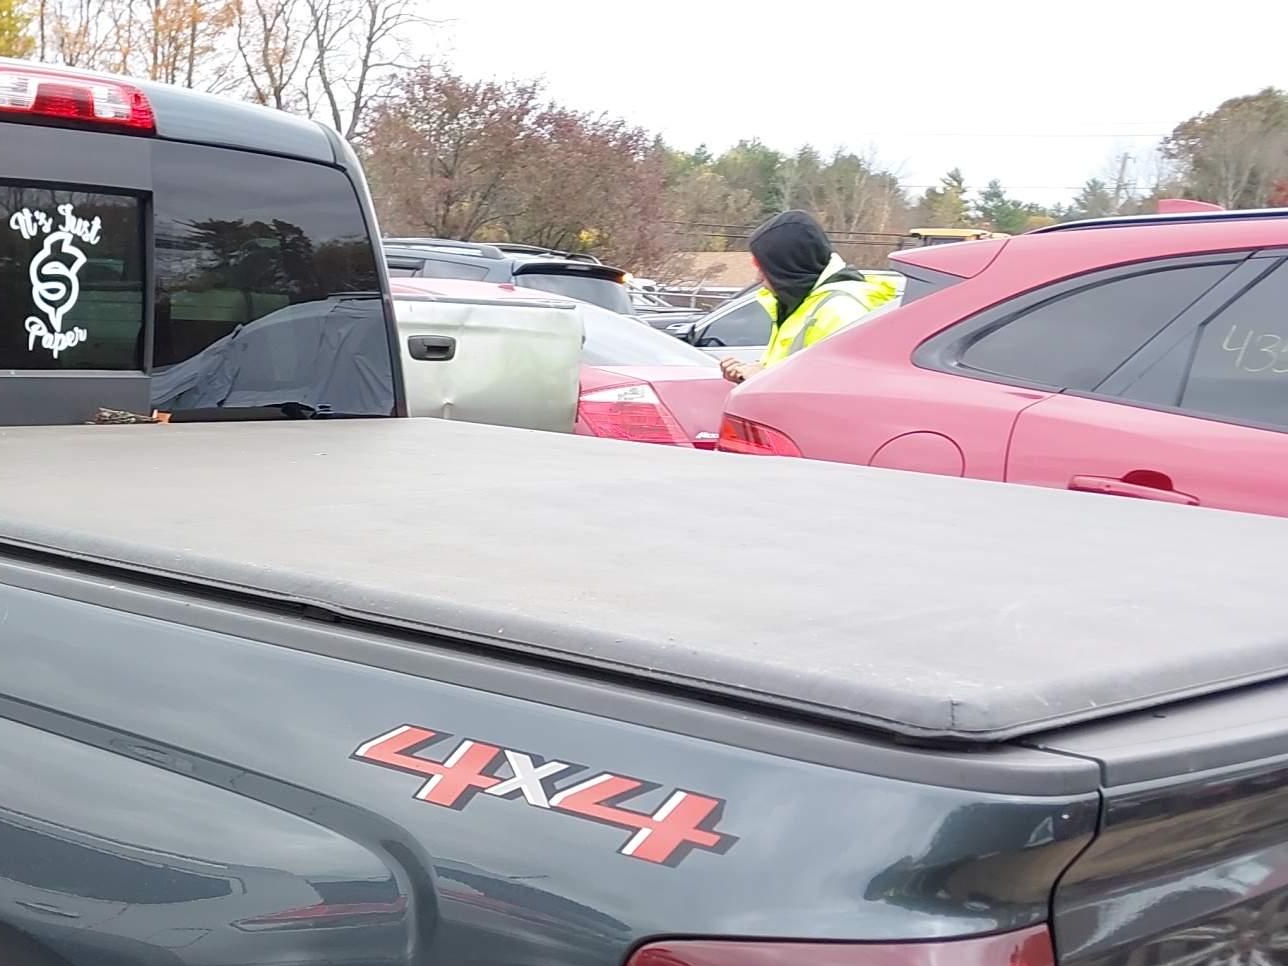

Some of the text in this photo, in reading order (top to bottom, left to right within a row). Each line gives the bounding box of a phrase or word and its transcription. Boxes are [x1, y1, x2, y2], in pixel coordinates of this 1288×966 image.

[10, 203, 102, 244] It's Just
[24, 316, 87, 359] Paper
